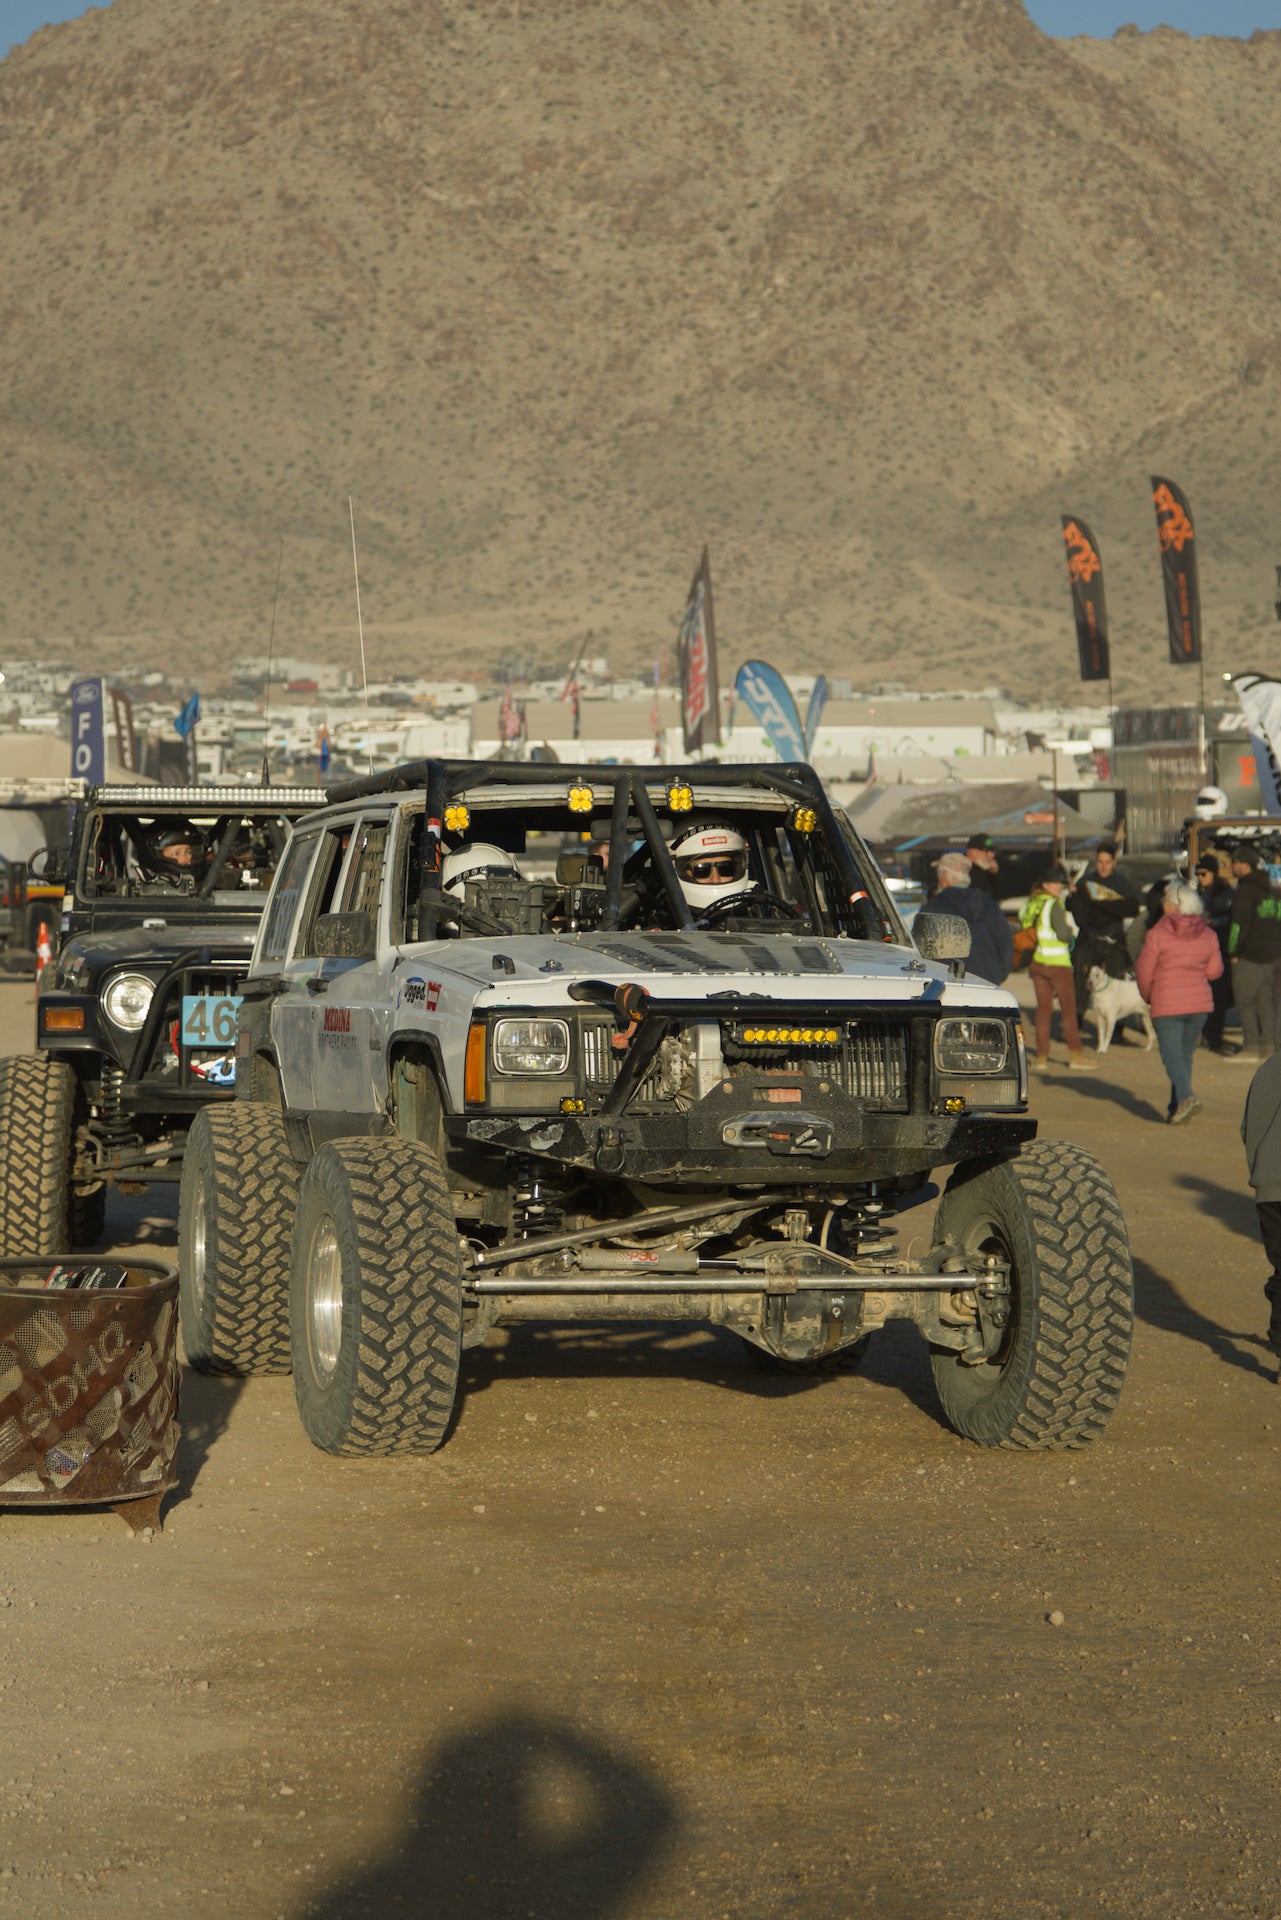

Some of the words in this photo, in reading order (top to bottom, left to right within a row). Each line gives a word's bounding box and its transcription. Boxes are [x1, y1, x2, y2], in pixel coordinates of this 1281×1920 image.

[322, 1007, 351, 1033] MEDINA
[629, 1250, 659, 1262] PSC
[21, 1320, 125, 1439] SDHQ
